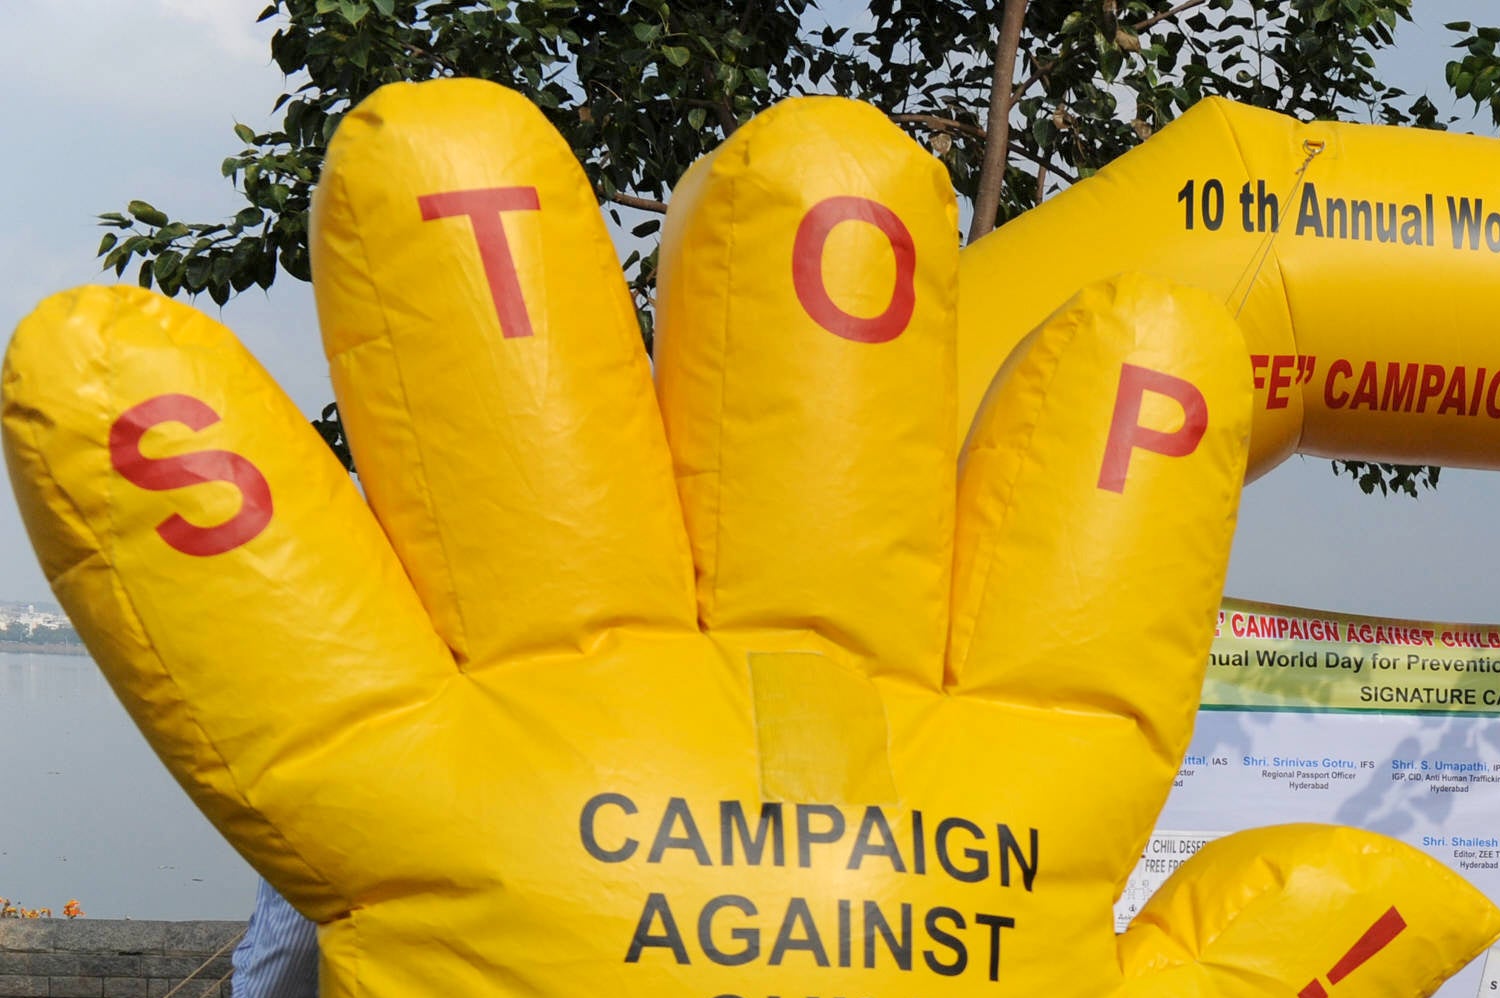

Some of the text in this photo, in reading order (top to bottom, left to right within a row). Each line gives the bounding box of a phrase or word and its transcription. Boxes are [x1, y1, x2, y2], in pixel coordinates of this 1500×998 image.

[1177, 179, 1224, 231] 10
[1240, 180, 1279, 233] th
[1296, 182, 1434, 246] Annual
[1232, 613, 1340, 643] CAMPAIGN
[1346, 622, 1434, 646] AGAINST
[1256, 651, 1317, 668] World
[1325, 652, 1364, 673] Day
[1371, 652, 1399, 671] for
[1360, 686, 1476, 705] SIGNATURE
[1243, 756, 1375, 769] Shri. Srinivas Gotru, IFS
[1391, 760, 1417, 770] Shri.
[1420, 761, 1431, 770] S.
[1435, 761, 1490, 773] Umapathi,
[579, 793, 1039, 892] CAMPAIGN
[1423, 836, 1448, 846] Shri.
[1451, 837, 1498, 848] Shailesh
[624, 893, 1015, 981] AGAINST
